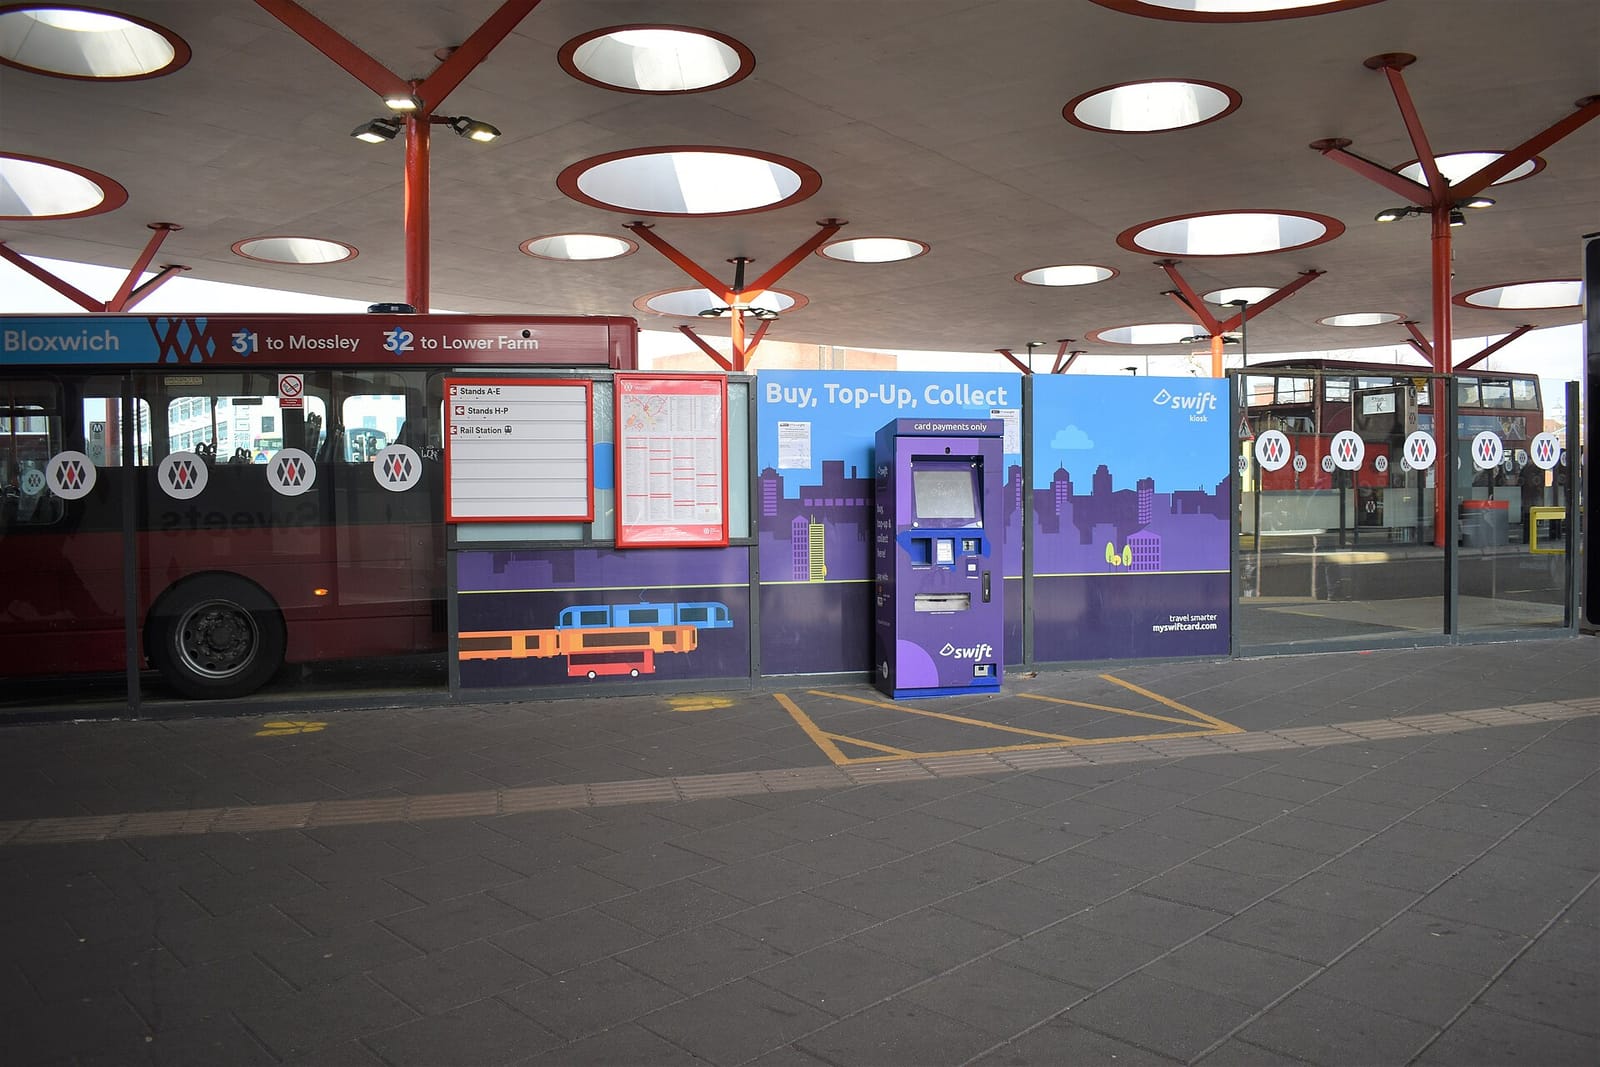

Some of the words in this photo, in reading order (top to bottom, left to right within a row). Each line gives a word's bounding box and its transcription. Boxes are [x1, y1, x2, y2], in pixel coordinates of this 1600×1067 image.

[4, 329, 119, 351] Bloxwich
[231, 333, 258, 353] 31
[266, 336, 284, 350] to
[289, 334, 360, 353] Mossley
[383, 331, 414, 352] 32
[420, 335, 438, 350] to
[443, 334, 494, 350] Lower
[498, 335, 538, 350] Farm
[460, 387, 486, 395] Stands
[487, 387, 501, 395] A-E
[766, 383, 817, 408] Buy,
[824, 383, 918, 408] Top-Up,
[924, 383, 1008, 406] Collect
[1171, 391, 1217, 414] swift
[468, 407, 493, 415] Stands
[495, 407, 509, 415] H-P
[1189, 414, 1208, 423] kiosk
[460, 426, 474, 434] Rail
[475, 426, 502, 434] Station
[914, 422, 931, 431] card
[932, 422, 969, 432] payments
[970, 422, 987, 432] only
[1169, 613, 1190, 622] travel
[1190, 613, 1217, 622] smarter
[1152, 622, 1217, 633] myswiftcard.com
[954, 643, 993, 662] swift
